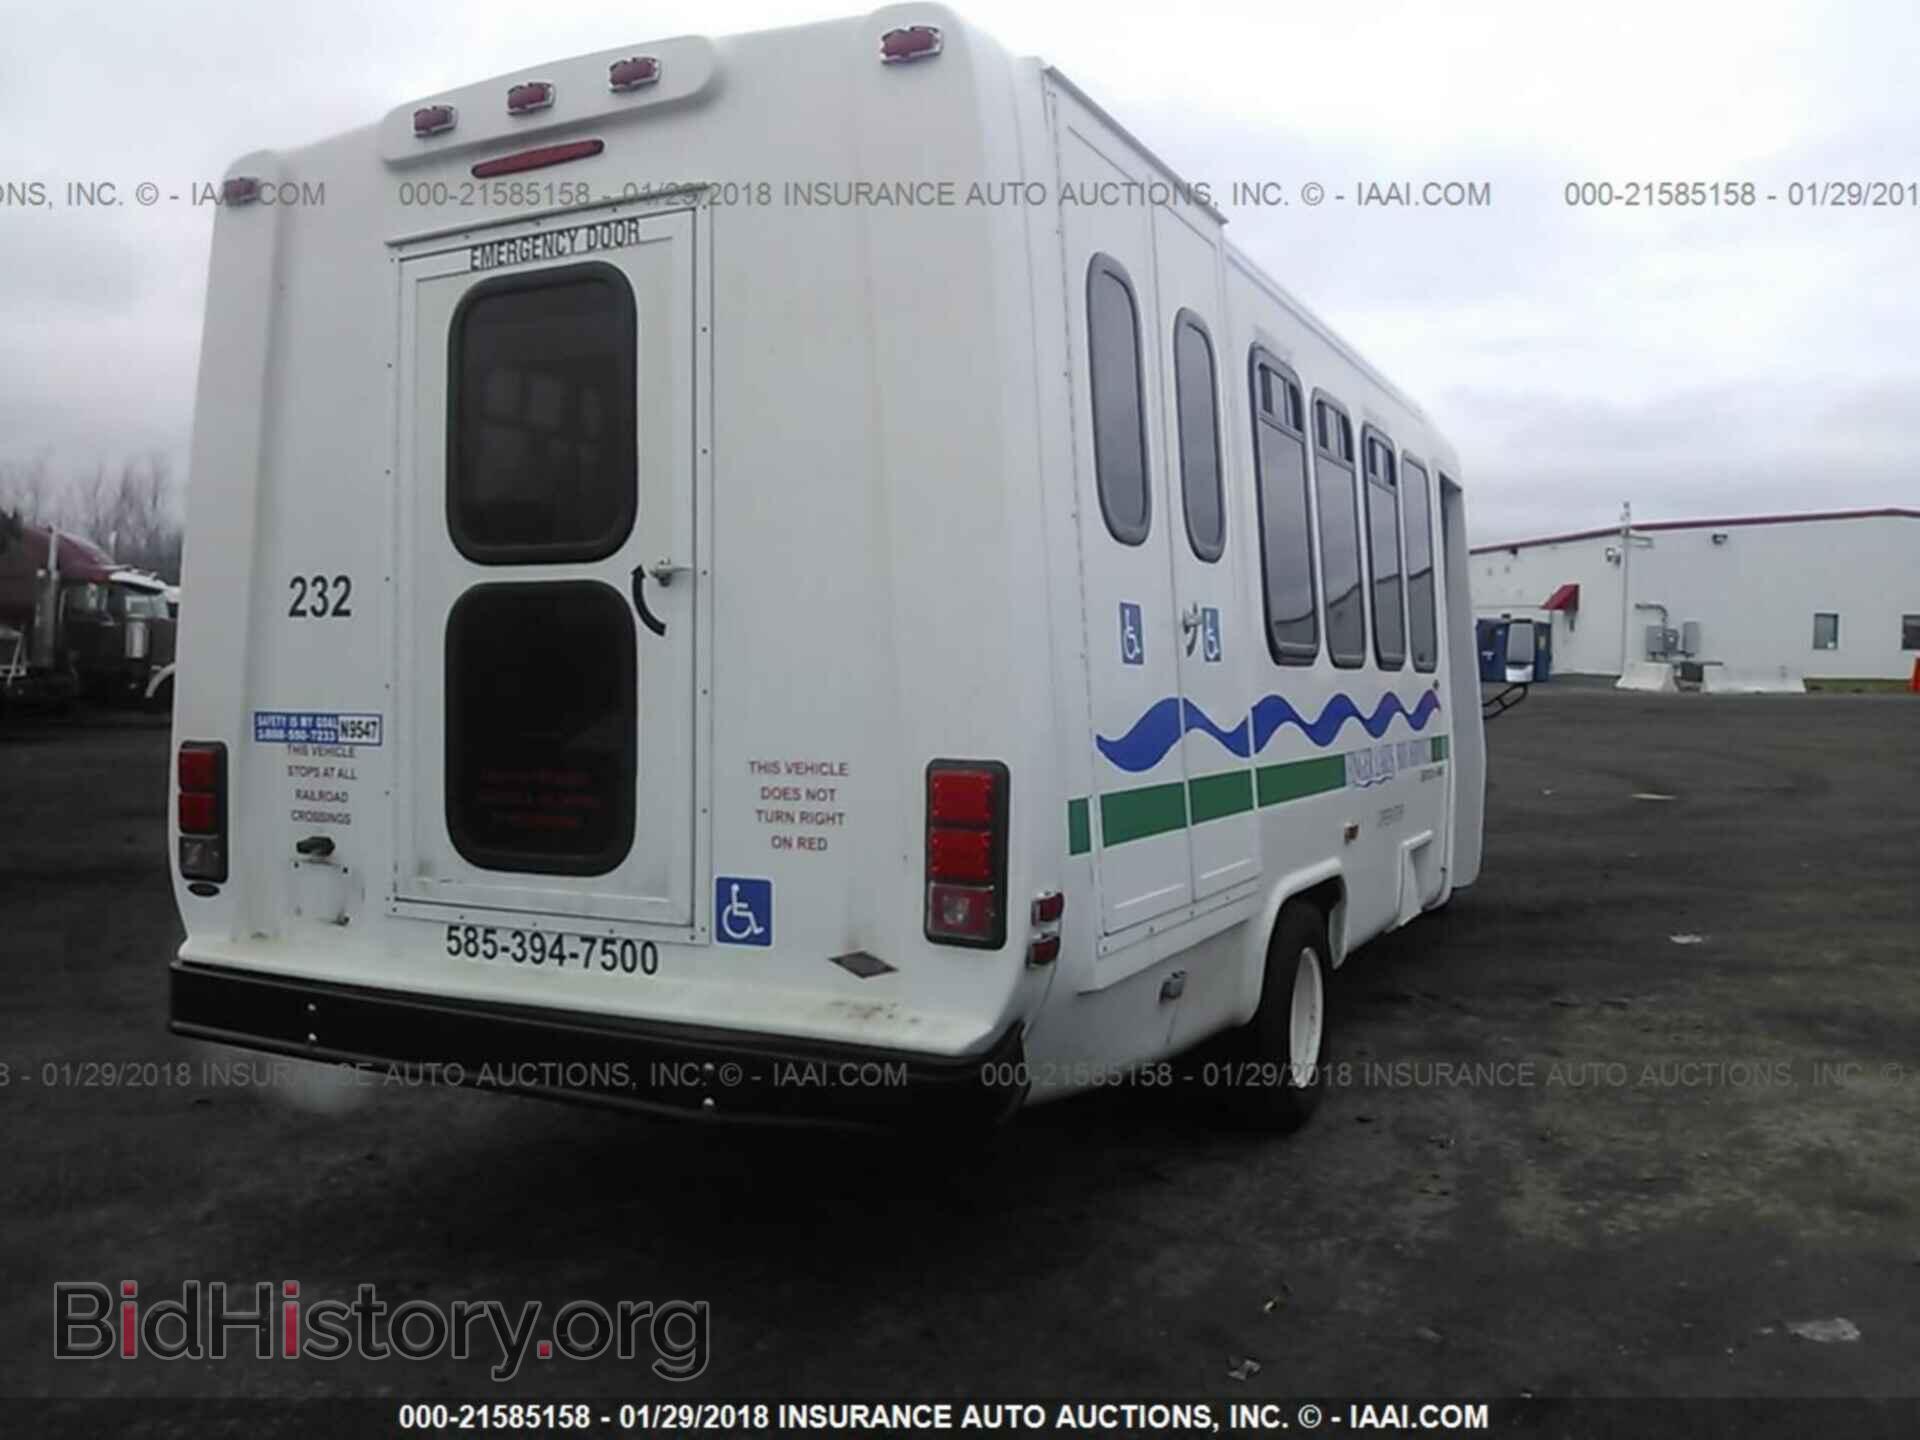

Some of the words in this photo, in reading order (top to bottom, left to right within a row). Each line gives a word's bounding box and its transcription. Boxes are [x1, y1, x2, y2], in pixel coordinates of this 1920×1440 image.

[469, 229, 578, 271] EMERGENCY
[586, 217, 640, 250] DOOR
[288, 575, 352, 618] 232
[340, 719, 378, 739] N9547
[287, 744, 309, 757] THIS
[312, 746, 356, 759] VEHICLE
[288, 765, 320, 778] STOPS
[322, 766, 335, 778] AT
[337, 767, 358, 780] ALL
[748, 760, 781, 775] THIS
[785, 761, 849, 777] VEHICLE
[295, 788, 348, 803] RAILROAD
[760, 786, 802, 801] DOES
[805, 787, 837, 802] NOT
[291, 810, 351, 825] CROSSINGS
[755, 809, 796, 824] TURN
[799, 811, 846, 827] RIGHT
[771, 835, 793, 850] ON
[797, 836, 829, 852] RED
[446, 925, 659, 975] 585-394-7500
